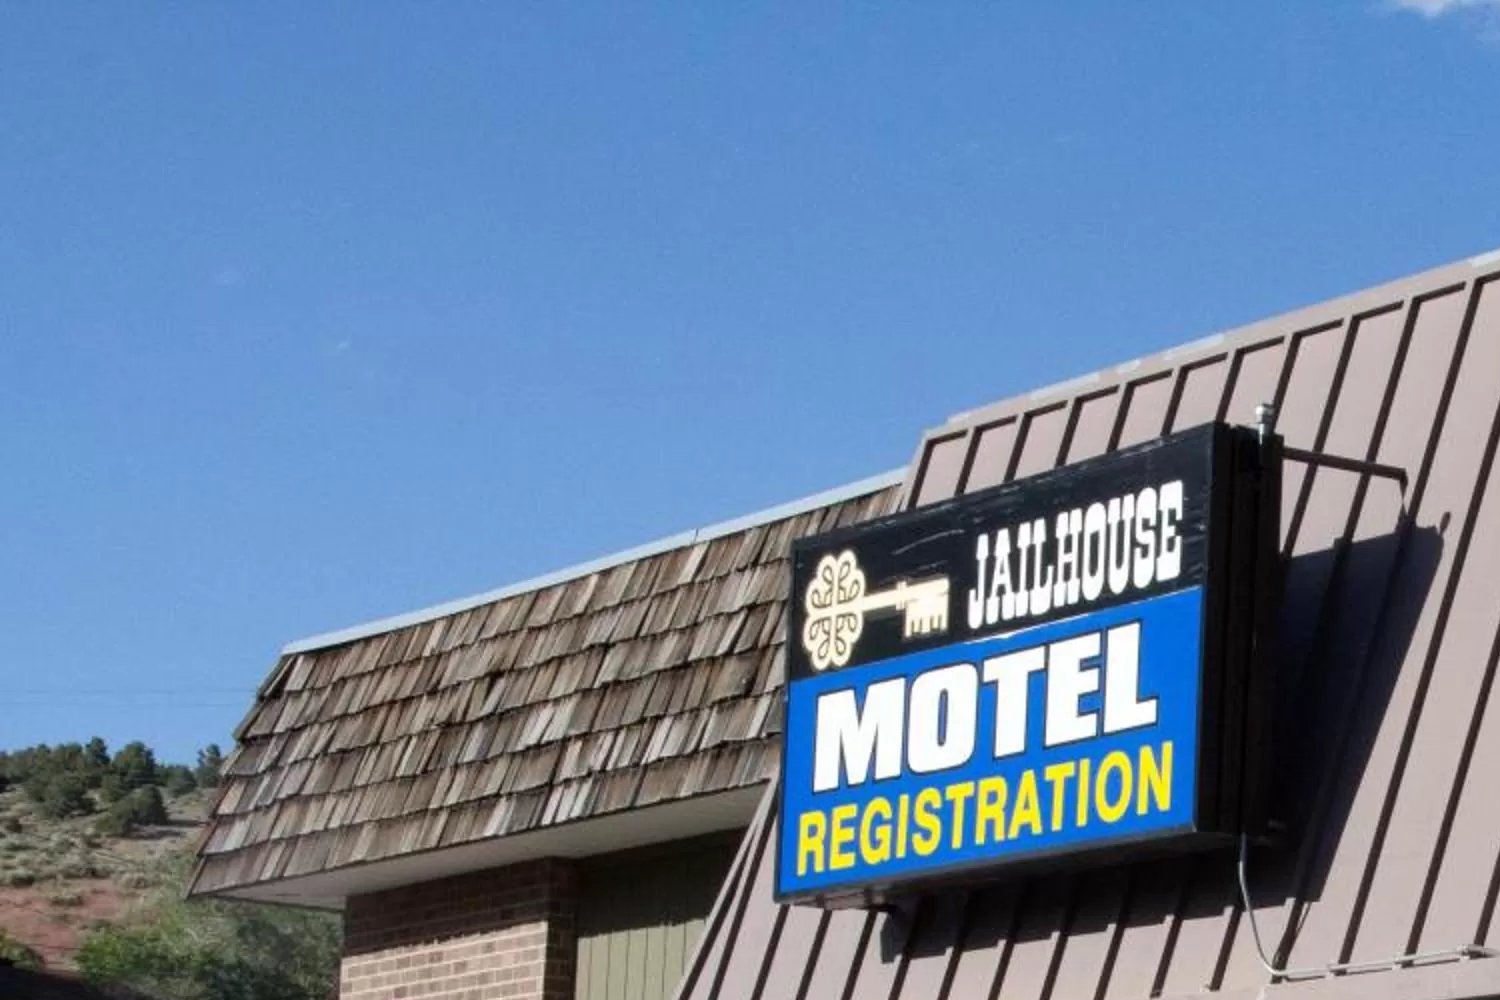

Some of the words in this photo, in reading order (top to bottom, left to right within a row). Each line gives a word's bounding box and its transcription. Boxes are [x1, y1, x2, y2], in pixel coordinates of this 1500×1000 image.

[967, 480, 1184, 630] JAILHOUSE
[811, 619, 1158, 794] MOTEL
[796, 740, 1174, 877] REGISTRATION
